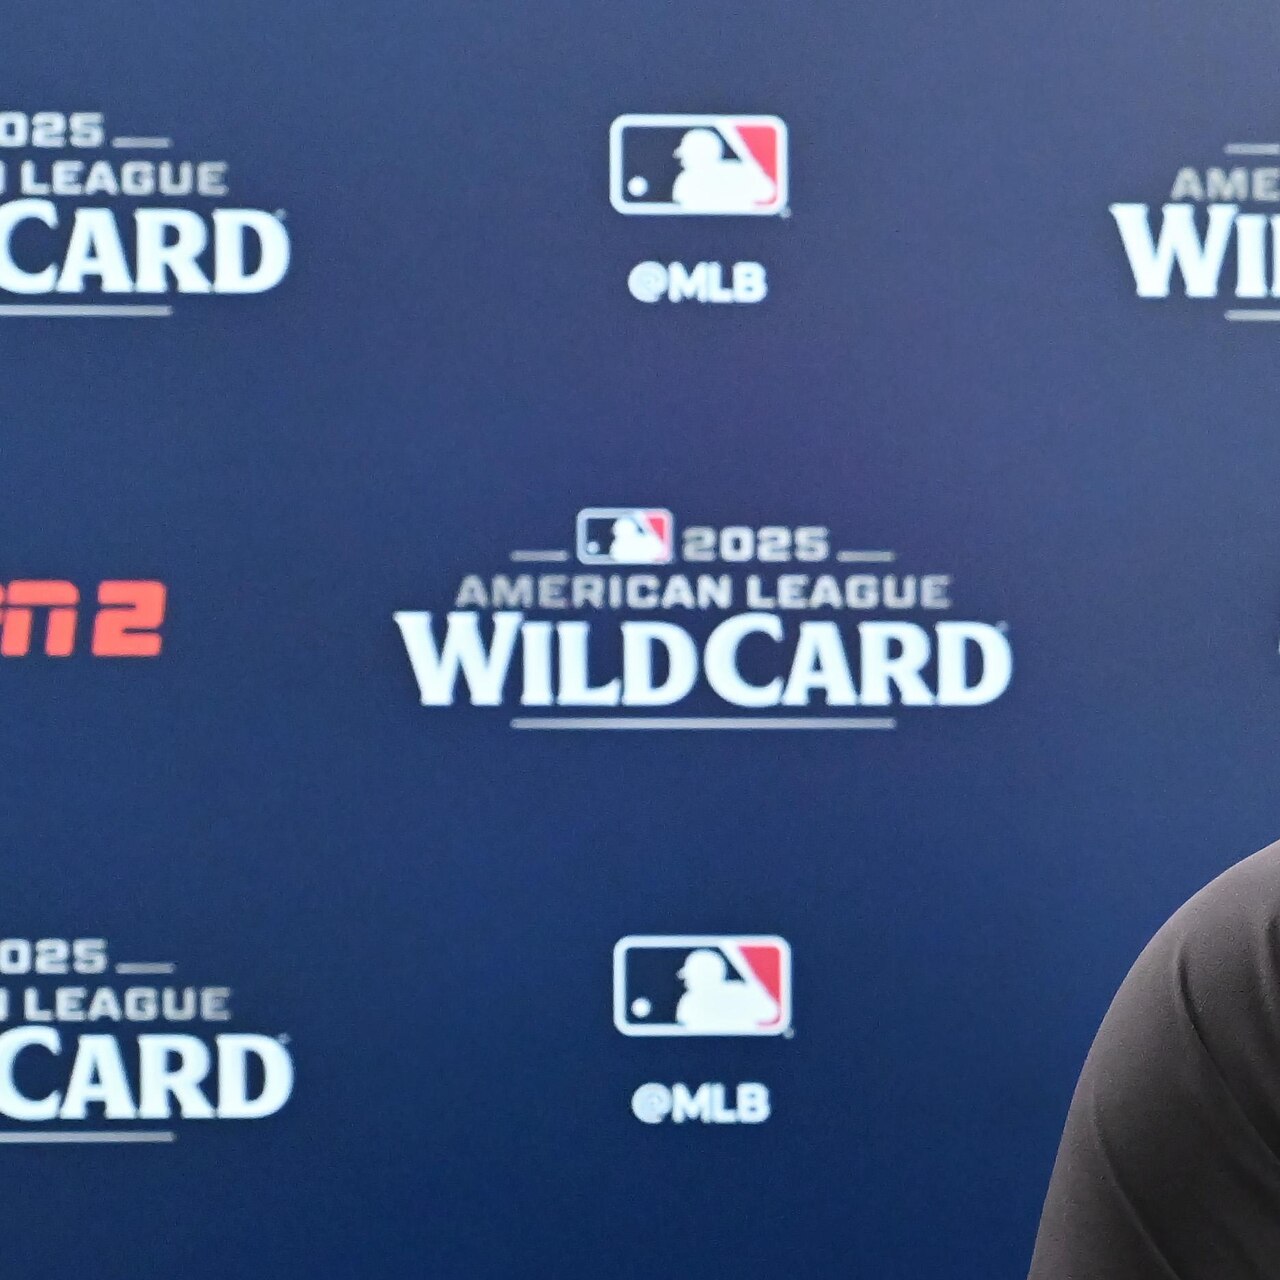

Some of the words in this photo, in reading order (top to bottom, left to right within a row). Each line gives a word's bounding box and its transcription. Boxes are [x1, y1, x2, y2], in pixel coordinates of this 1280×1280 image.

[21, 161, 227, 196] LEAGUE
[628, 261, 767, 303] @MLB
[684, 527, 828, 561] 2025
[457, 575, 732, 608] AMERICAN
[747, 575, 949, 609] LEAGUE
[25, 987, 228, 1021] LEAGUE
[632, 1083, 770, 1123] @MLB
